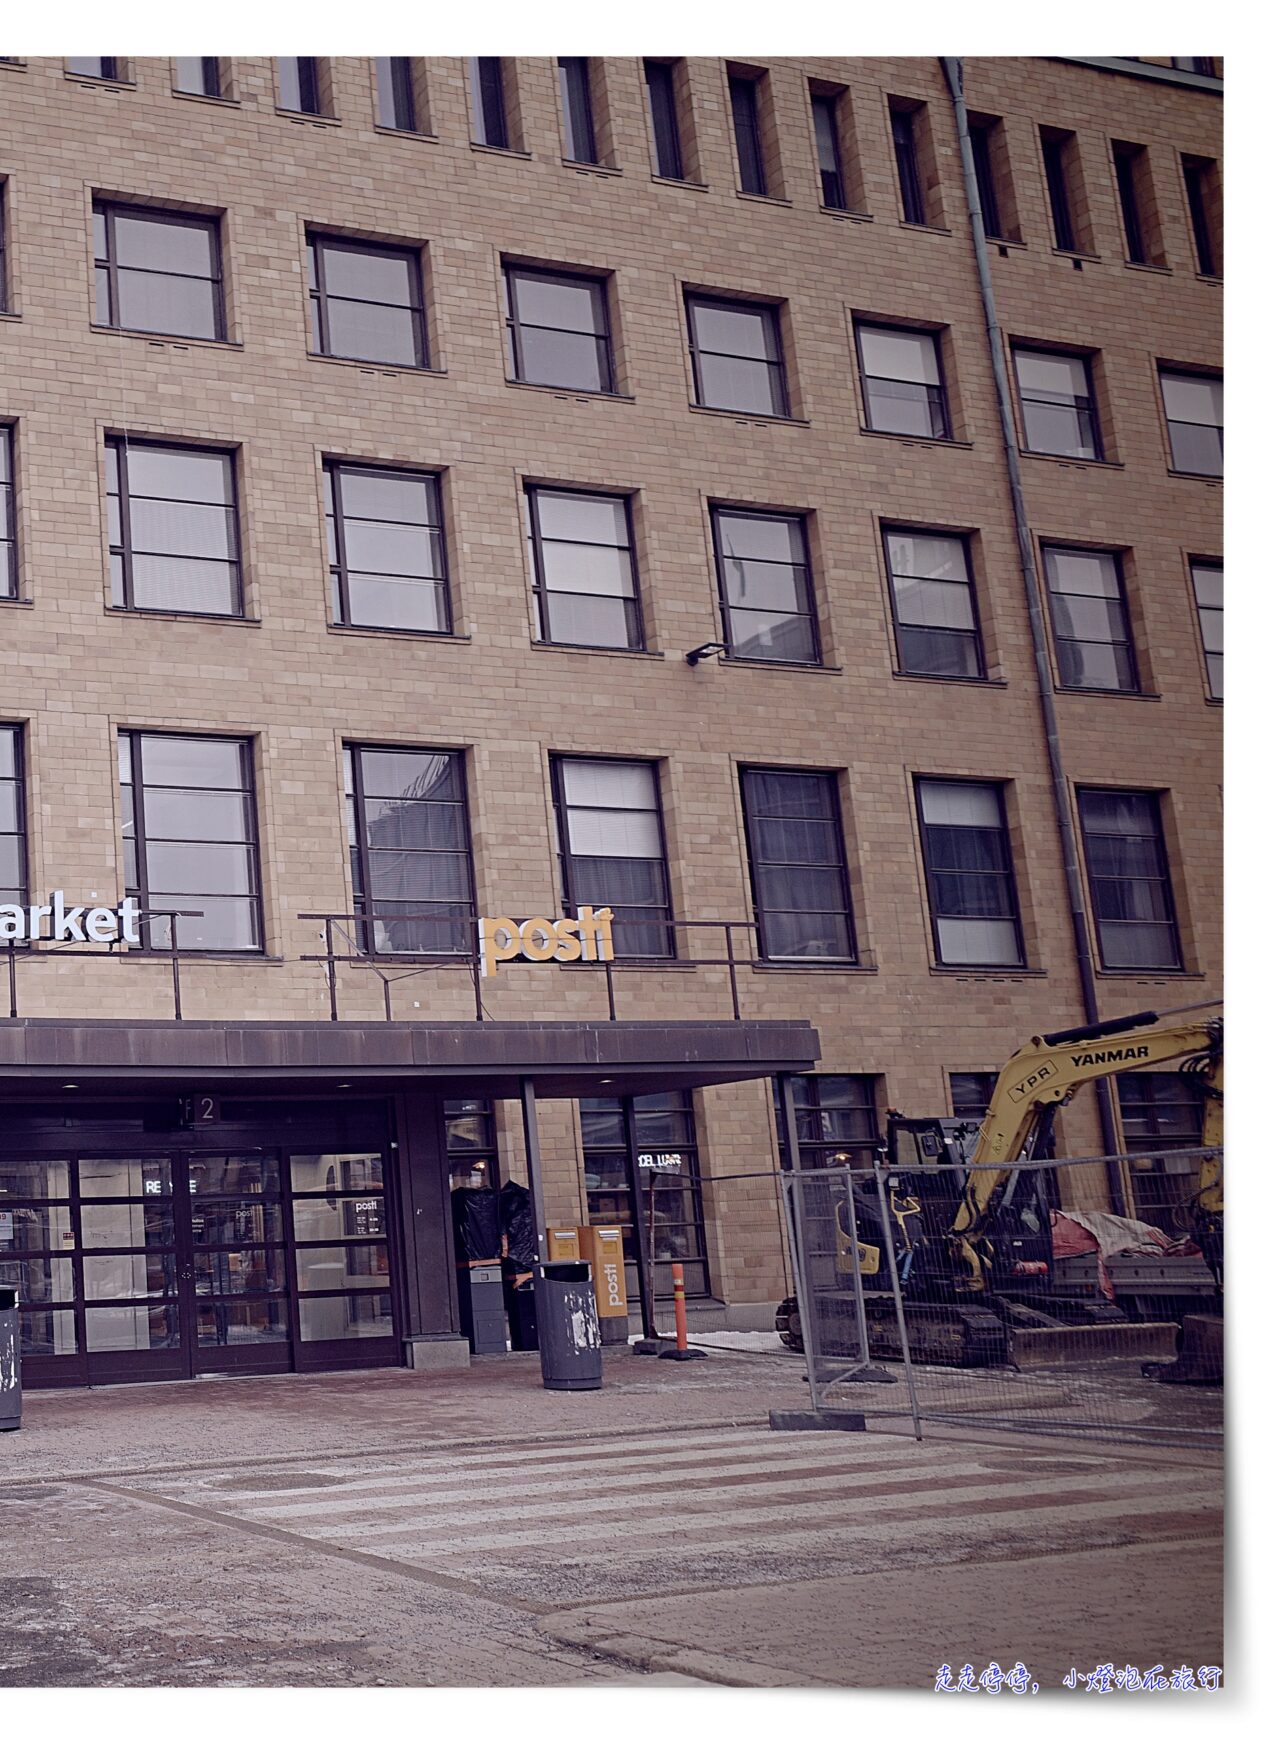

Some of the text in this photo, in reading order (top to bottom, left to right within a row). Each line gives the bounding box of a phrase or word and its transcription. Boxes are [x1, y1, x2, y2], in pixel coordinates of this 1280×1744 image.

[478, 906, 615, 977] posti
[1071, 1046, 1149, 1067] YANMAR
[1014, 1066, 1051, 1094] YPR
[201, 1097, 214, 1119] 2
[603, 1264, 623, 1306] posti
